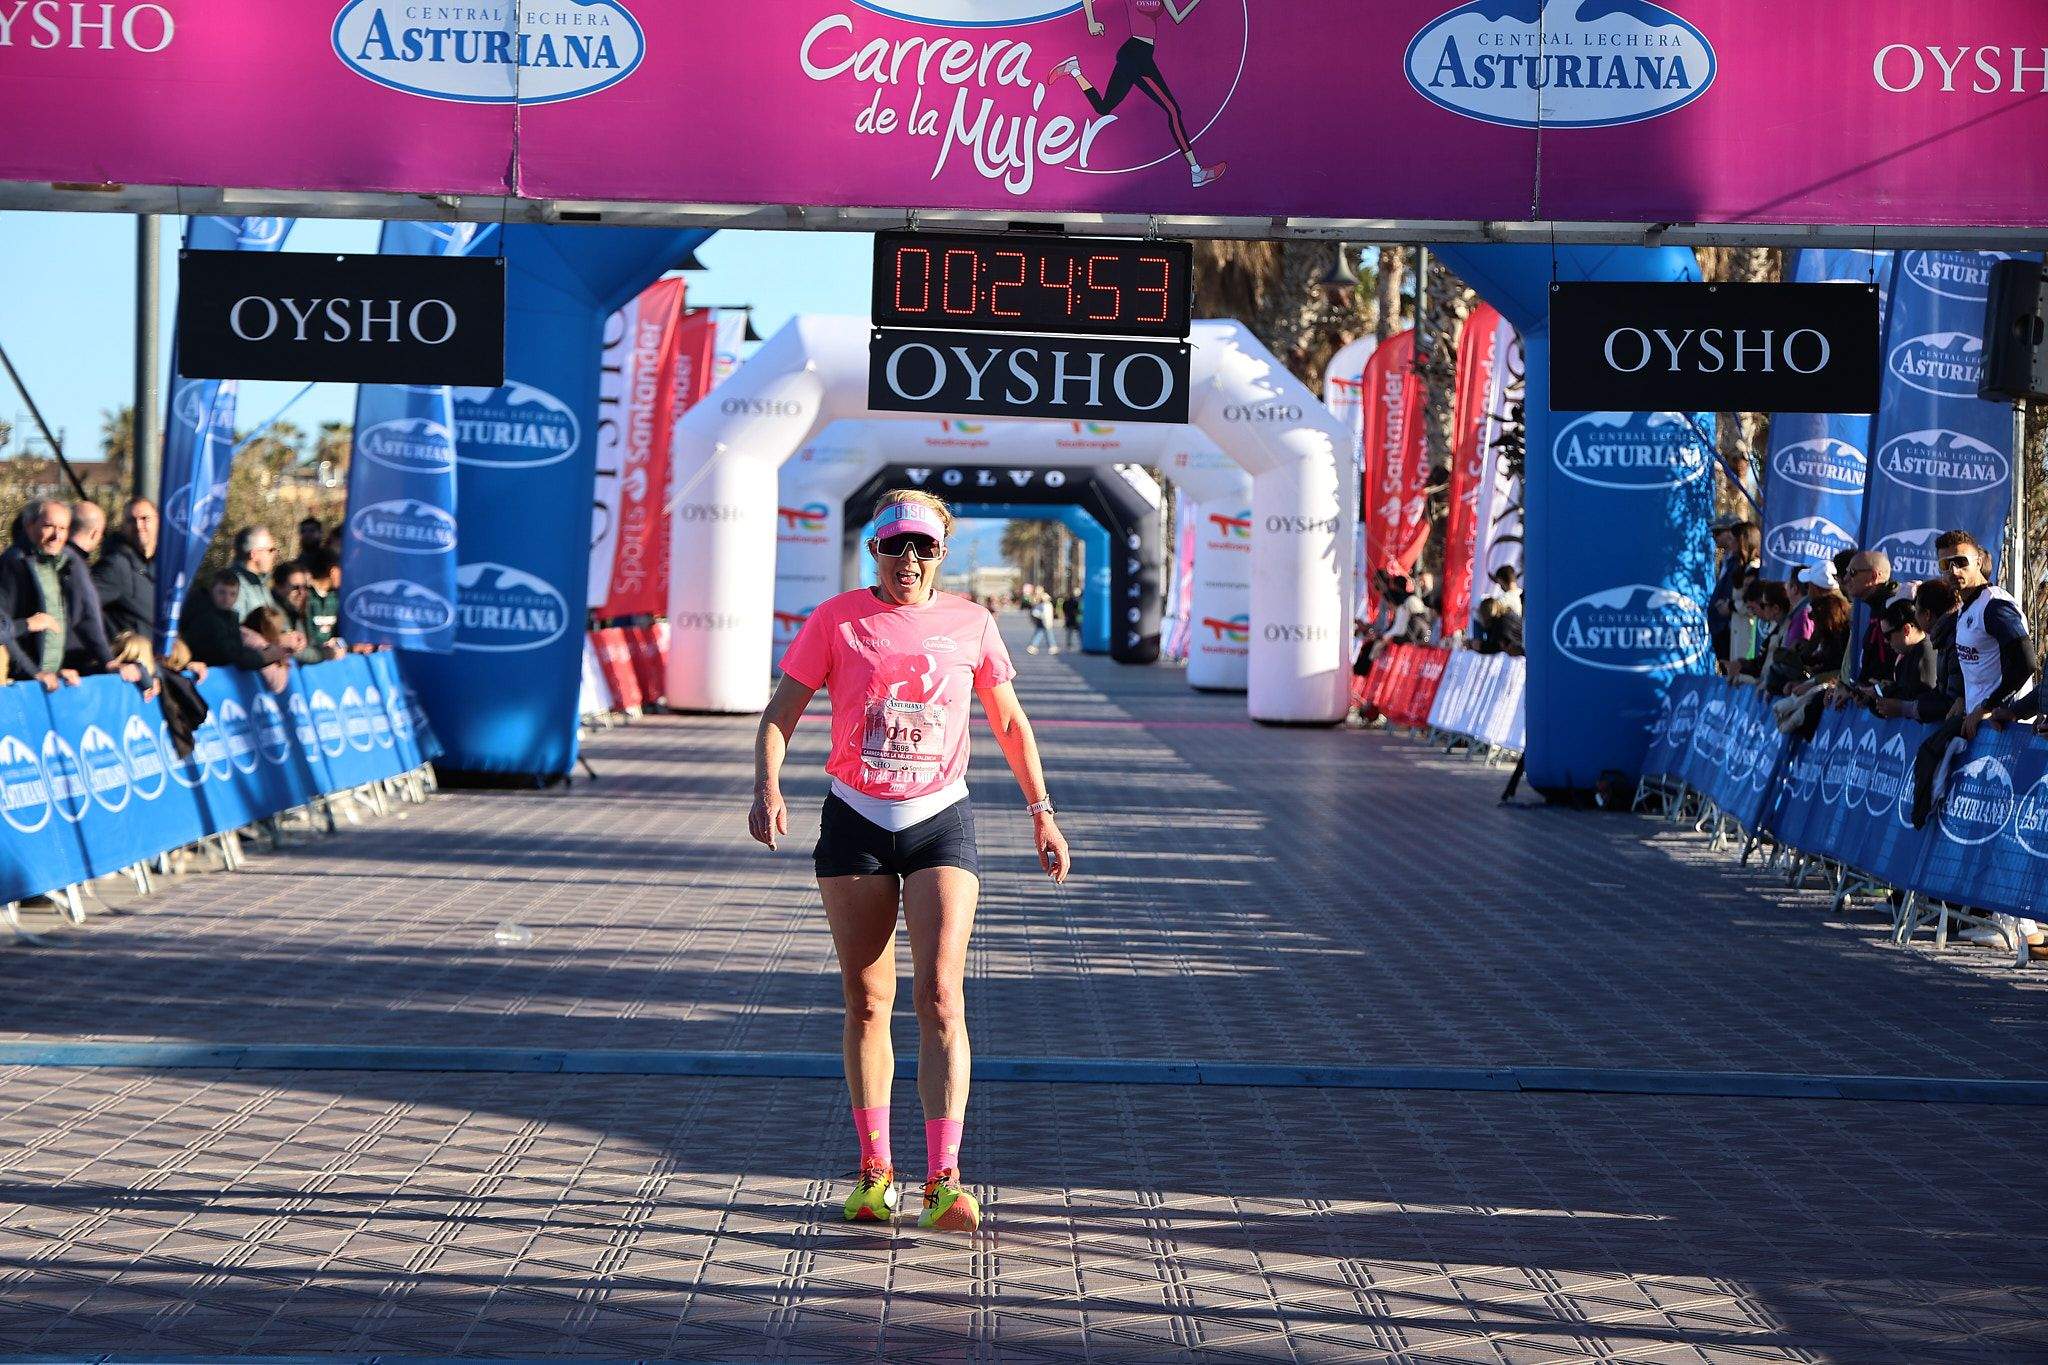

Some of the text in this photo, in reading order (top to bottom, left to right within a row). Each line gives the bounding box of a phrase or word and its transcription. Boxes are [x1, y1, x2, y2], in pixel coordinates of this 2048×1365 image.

[405, 6, 611, 26] CENTRAL LECHERA
[356, 8, 621, 69] ASTURIANA
[800, 14, 1032, 87] Carrera
[1478, 32, 1682, 47] CENTRAL LECHERA
[1428, 35, 1692, 90] ASTURIANA
[1873, 43, 2048, 94] OYSH
[855, 82, 1118, 195] de la Mujer
[895, 247, 1169, 323] 00:24:53
[1913, 251, 1989, 286] ASTURI
[229, 295, 457, 345] OYSHO
[1604, 327, 1831, 374] OYSHO
[1899, 348, 1985, 382] ASTURIA
[626, 320, 662, 465] Santander
[885, 342, 1175, 411] OYSHO
[721, 397, 802, 417] OYSHO
[1223, 404, 1303, 423] OYSHO
[453, 420, 571, 450] TURIANA
[1381, 370, 1404, 494] Santander
[1887, 446, 1997, 481] ASTURIANA
[1906, 448, 1947, 458] CENTRAL
[905, 467, 1066, 488] VOLVO
[681, 503, 744, 523] OYSH
[1264, 623, 1330, 643] OYSH
